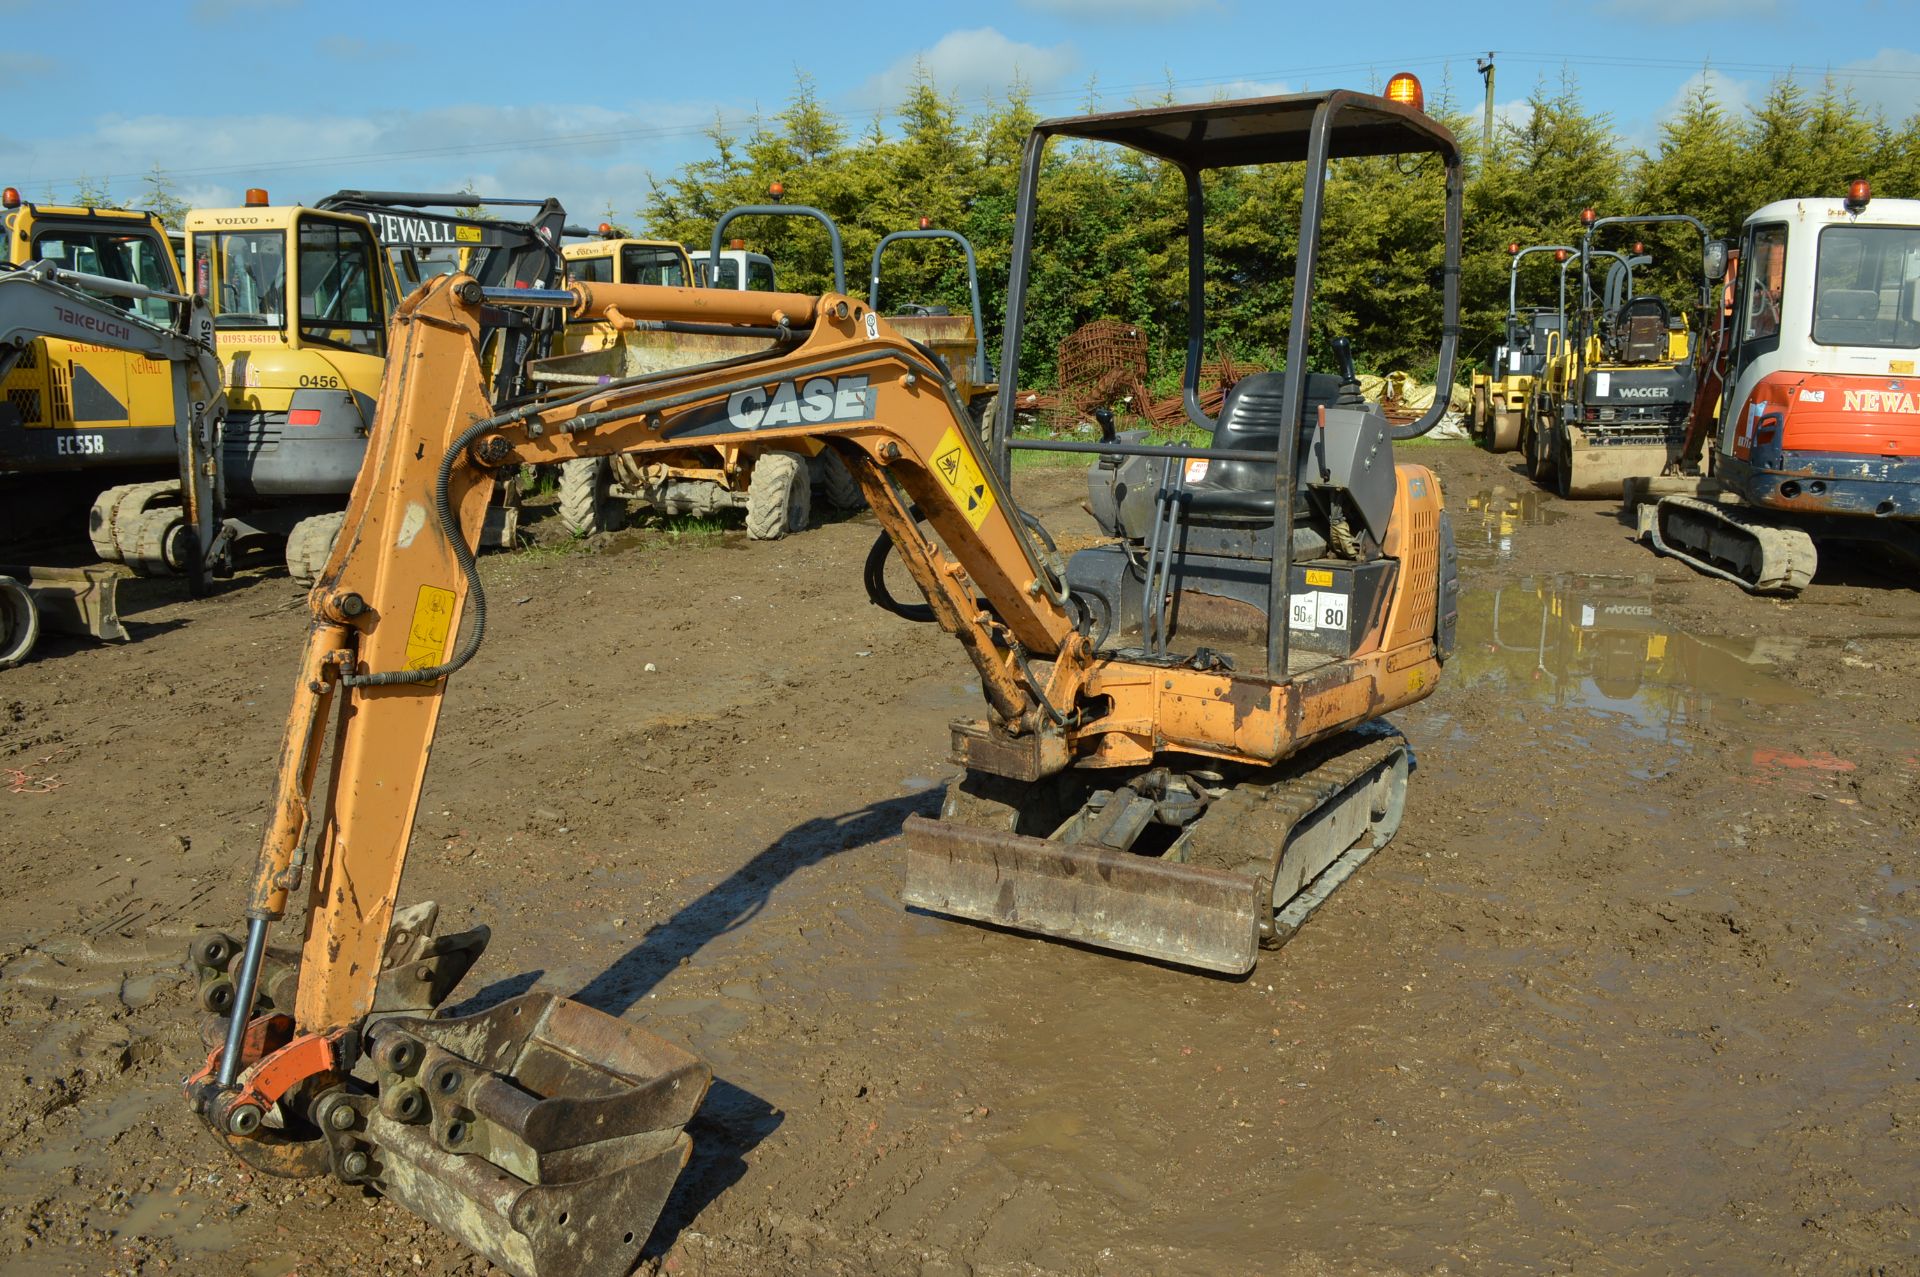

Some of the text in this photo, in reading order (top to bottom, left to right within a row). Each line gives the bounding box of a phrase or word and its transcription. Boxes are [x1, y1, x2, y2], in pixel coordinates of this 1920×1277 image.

[216, 217, 258, 225] VOLVO
[367, 212, 456, 243] NEWALL
[67, 343, 88, 353] Tel:
[222, 334, 246, 344] 01953
[248, 334, 277, 344] 456119
[299, 375, 338, 388] 0456
[1618, 387, 1669, 398] WACKER
[727, 375, 868, 430] CASE
[1842, 389, 1920, 415] NEWA
[57, 434, 105, 455] EC55B
[1293, 605, 1307, 623] 96
[1325, 608, 1344, 626] 80
